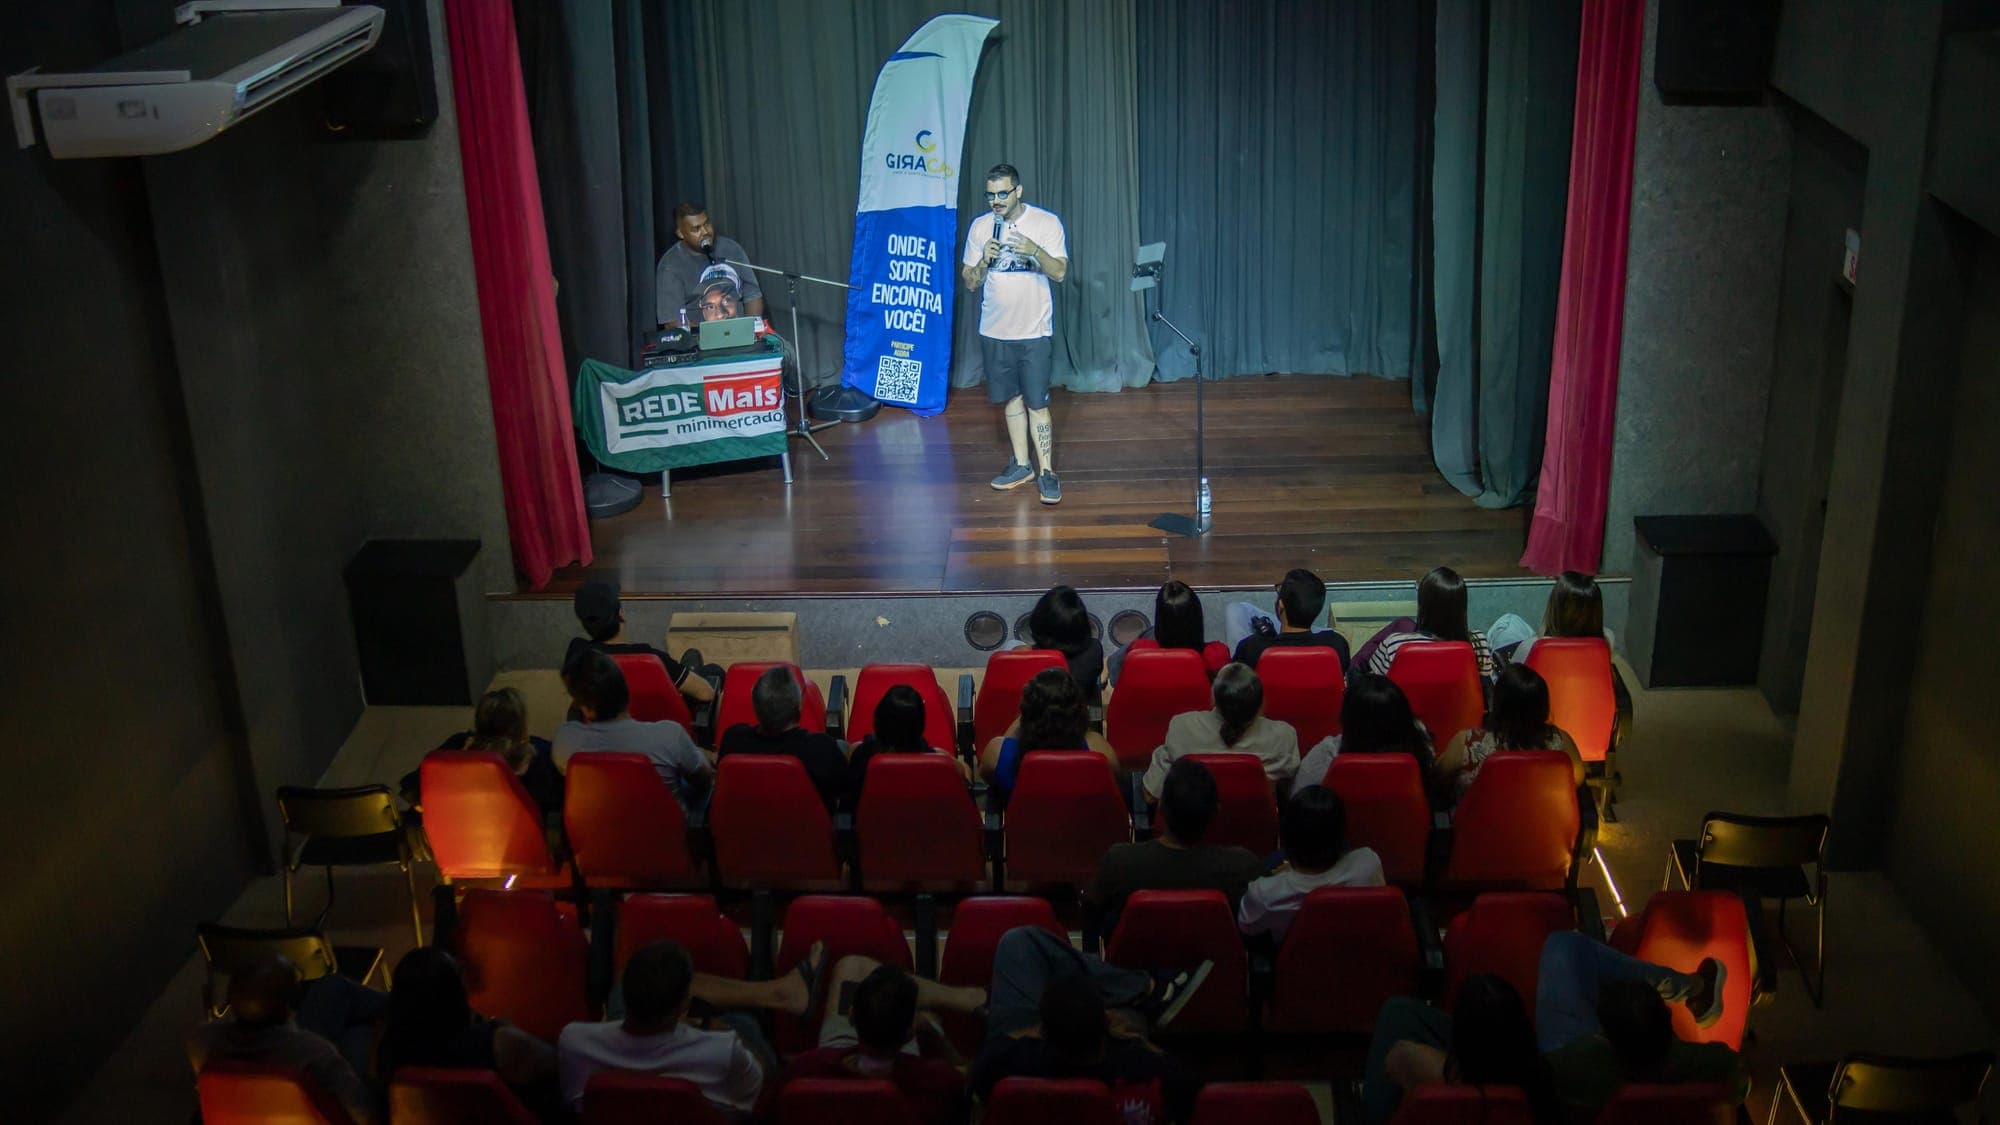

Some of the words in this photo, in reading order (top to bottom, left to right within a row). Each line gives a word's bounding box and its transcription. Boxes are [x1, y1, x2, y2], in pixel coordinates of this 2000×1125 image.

[888, 234, 926, 258] ONDE
[927, 241, 937, 262] A
[889, 260, 931, 285] SORTE
[872, 283, 942, 314] ENCONTRA
[885, 309, 926, 333] VOCÊ!
[623, 392, 701, 422] REDE
[708, 385, 776, 412] Mais
[677, 411, 783, 434] minimercado
